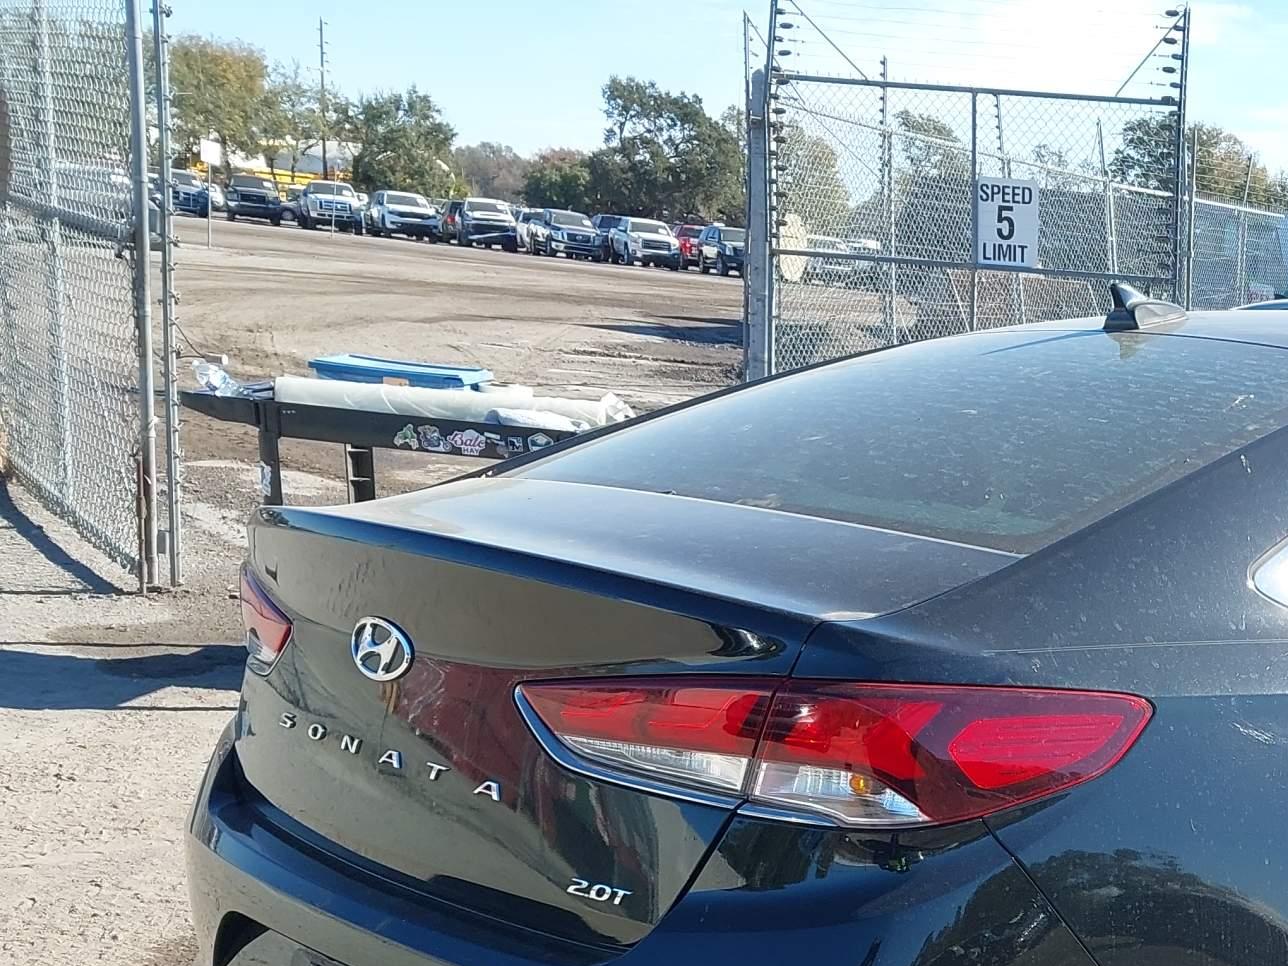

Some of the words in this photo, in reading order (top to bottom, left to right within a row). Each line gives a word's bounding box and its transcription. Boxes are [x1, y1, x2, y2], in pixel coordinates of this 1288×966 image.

[980, 184, 1033, 205] SPEED
[997, 205, 1015, 241] 5
[982, 242, 1028, 263] LIMIT
[279, 711, 501, 802] SONATA
[566, 878, 634, 905] 2.0T
